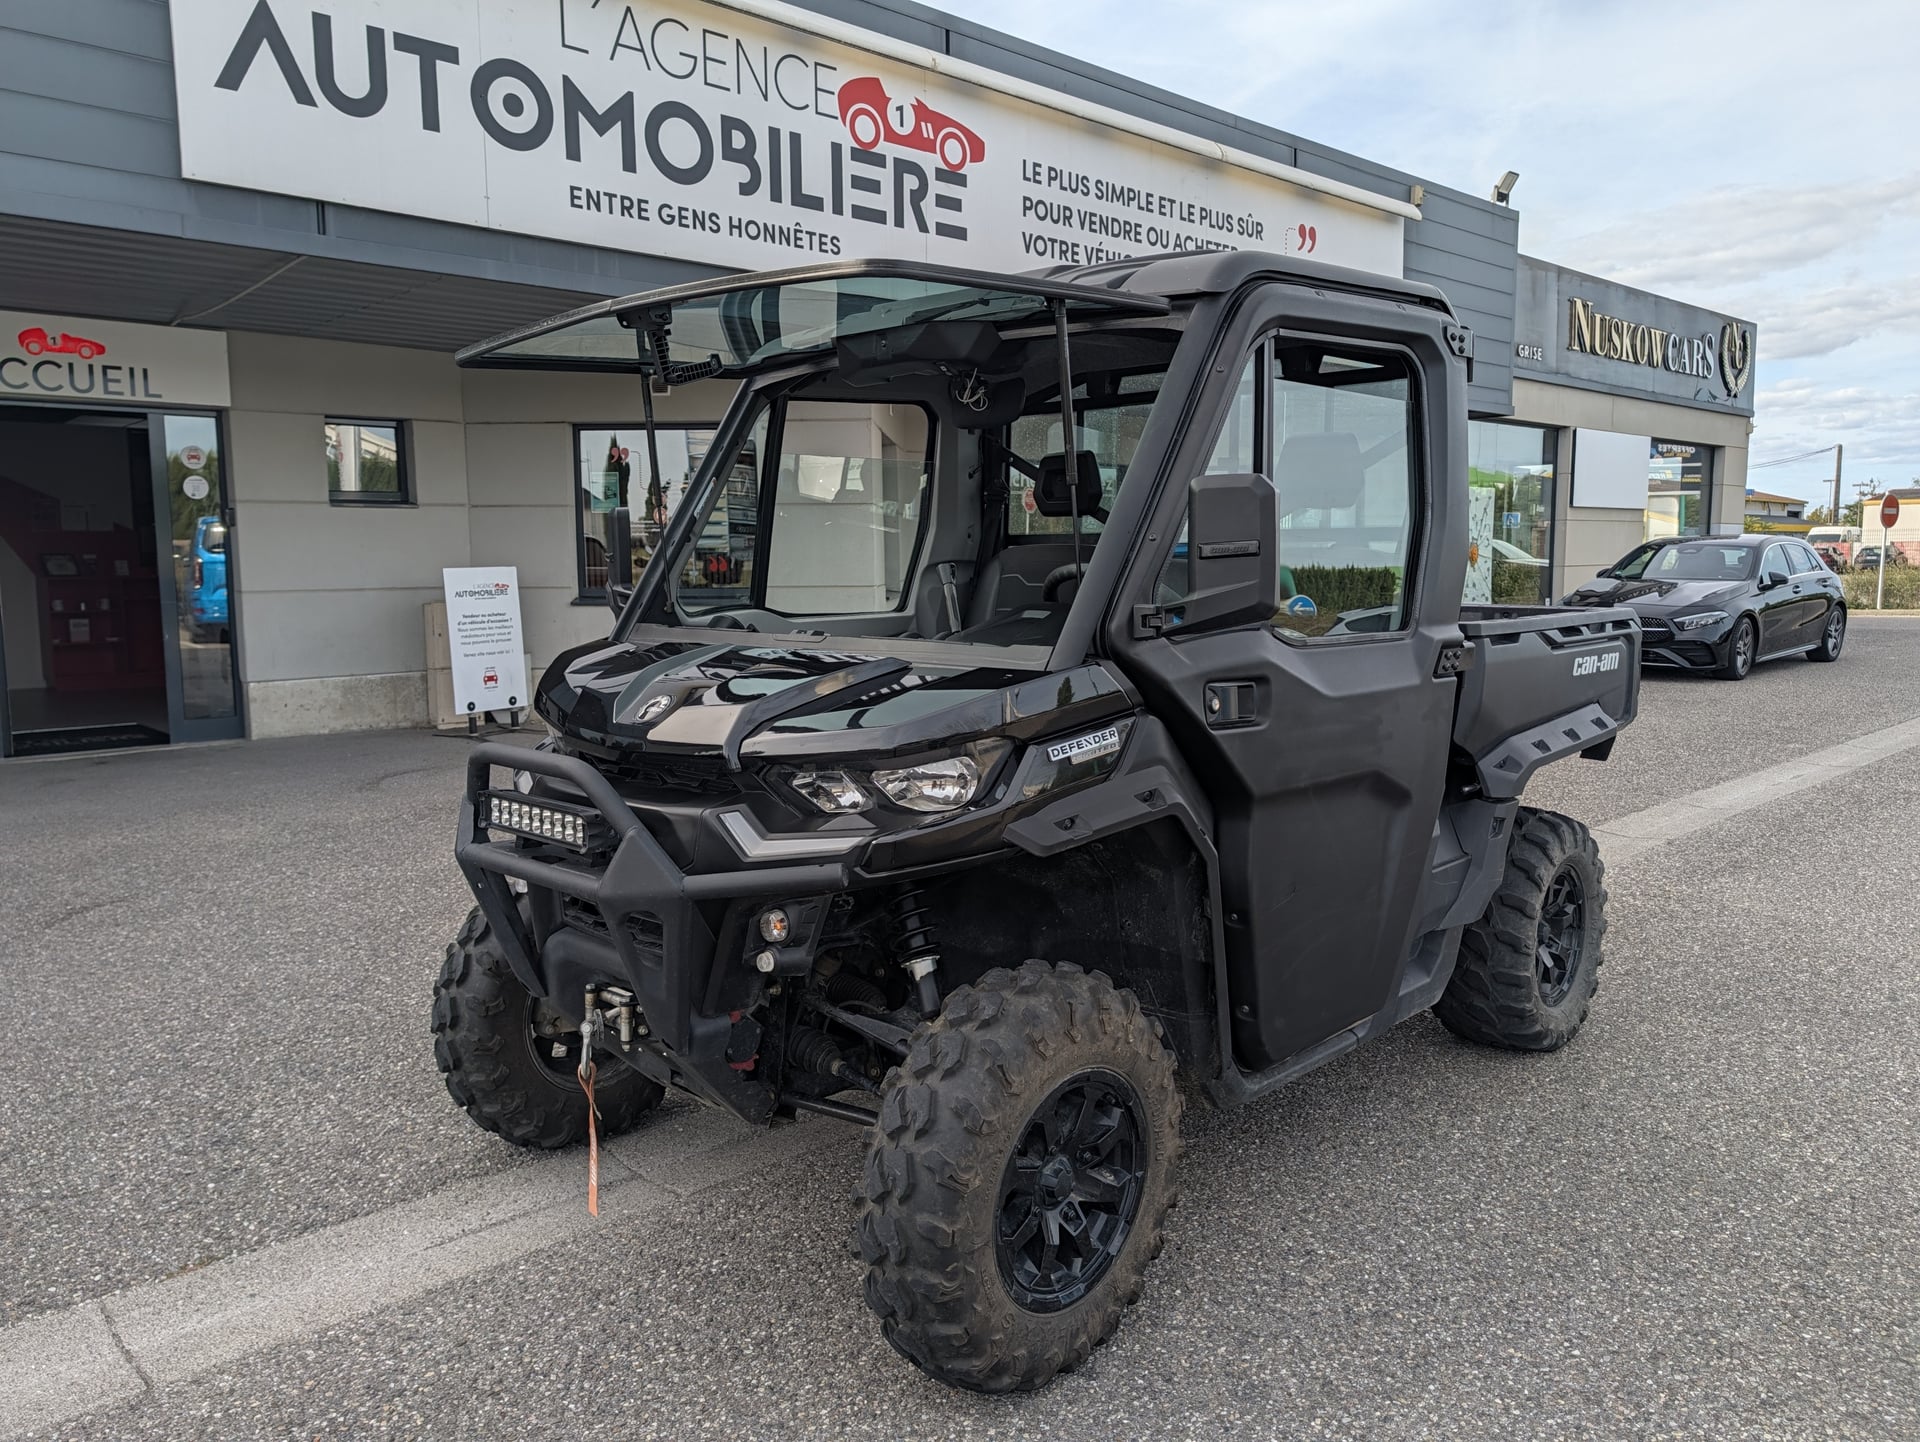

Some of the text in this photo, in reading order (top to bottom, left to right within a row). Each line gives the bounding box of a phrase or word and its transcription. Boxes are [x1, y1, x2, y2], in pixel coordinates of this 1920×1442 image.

[1022, 158, 1264, 240] LE PLUS SIMPLE ET LE PLUS SÛR
[569, 185, 842, 256] ENTRE GENS HONNÊTES
[1022, 195, 1073, 228] POUR
[1077, 208, 1142, 244] VENDRE
[1147, 226, 1169, 249] OU
[1022, 232, 1080, 264] VOTRE
[1517, 344, 1542, 361] GRISE
[1572, 652, 1620, 677] can-am
[1051, 729, 1117, 758] DEFENDER
